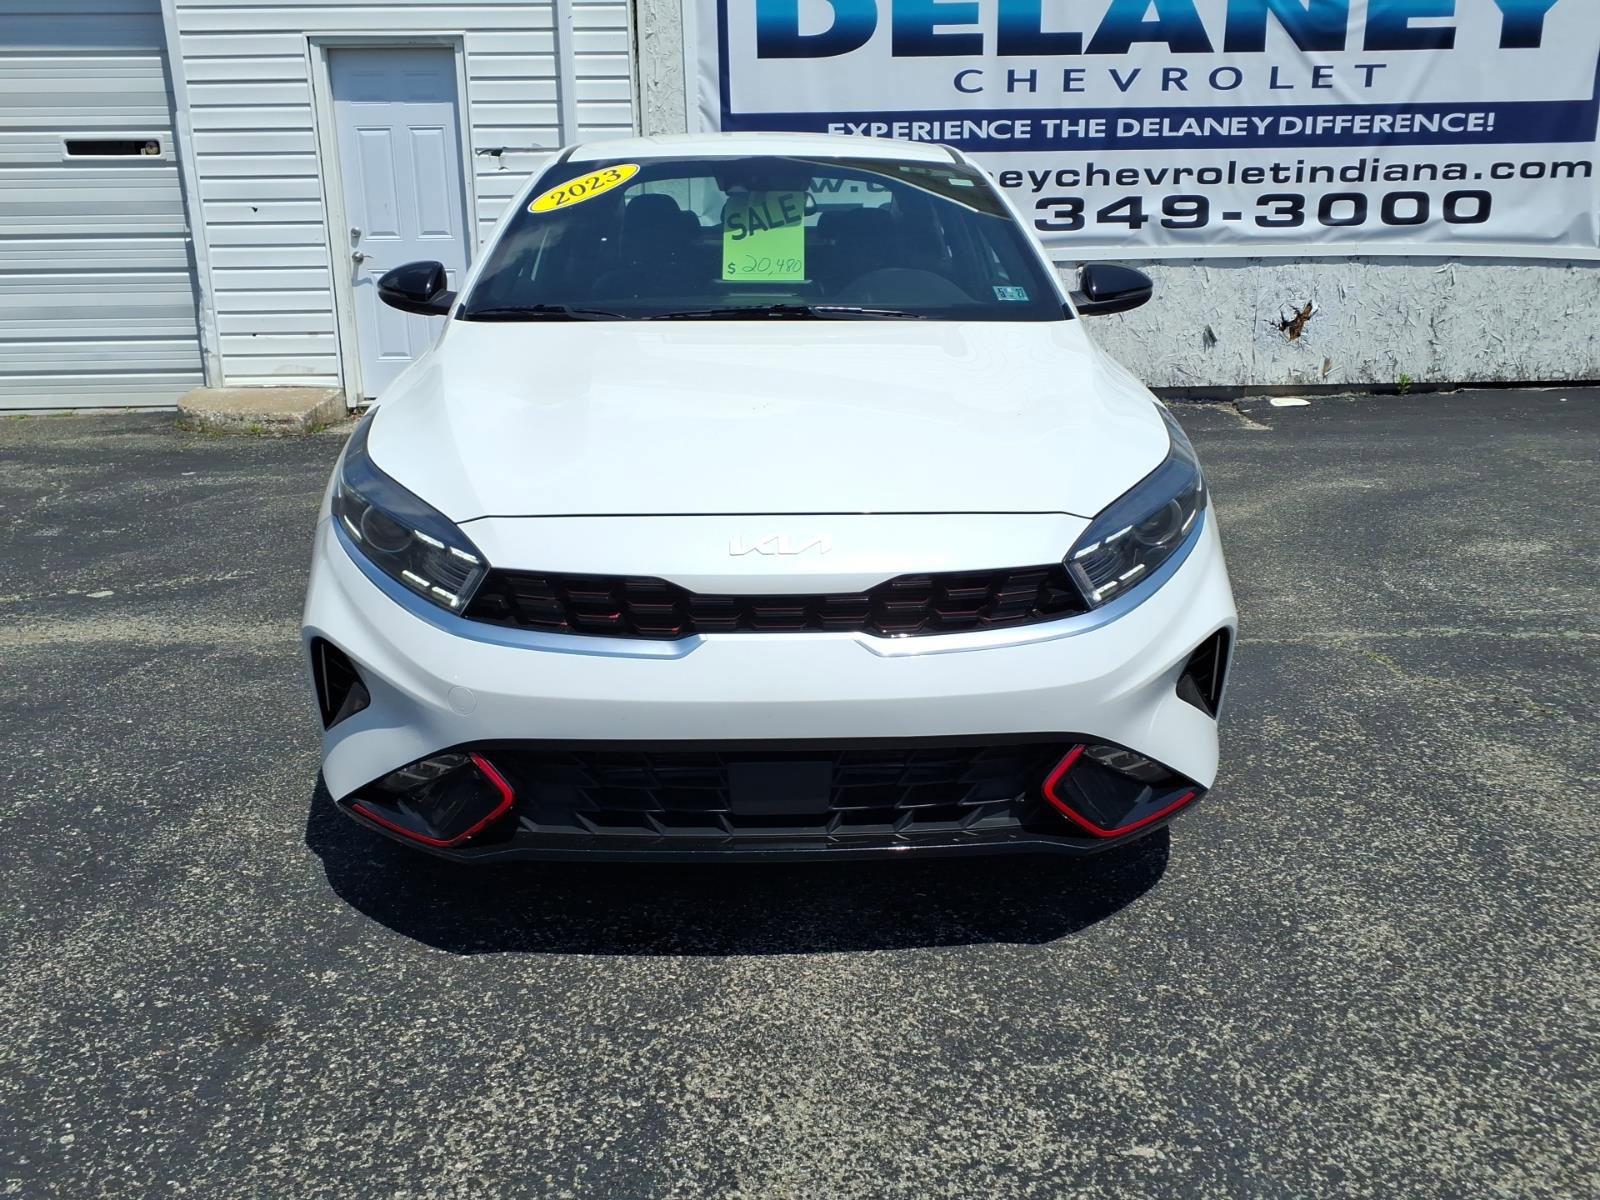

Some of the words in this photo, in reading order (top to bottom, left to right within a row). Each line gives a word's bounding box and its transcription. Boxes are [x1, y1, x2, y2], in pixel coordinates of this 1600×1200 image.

[757, 0, 1560, 58] DELANEY
[953, 63, 1387, 93] CHEVROLET
[827, 119, 1031, 141] EXPERIENCE
[1041, 118, 1106, 138] THE
[1117, 116, 1274, 138] DELANEY
[1278, 112, 1496, 135] DIFFERENCE!
[550, 169, 622, 206] 2023
[990, 158, 1593, 192] eychevroletindiana.com
[727, 192, 803, 241] SALE
[1034, 189, 1493, 232] 349-3000
[728, 535, 833, 557] KIA
